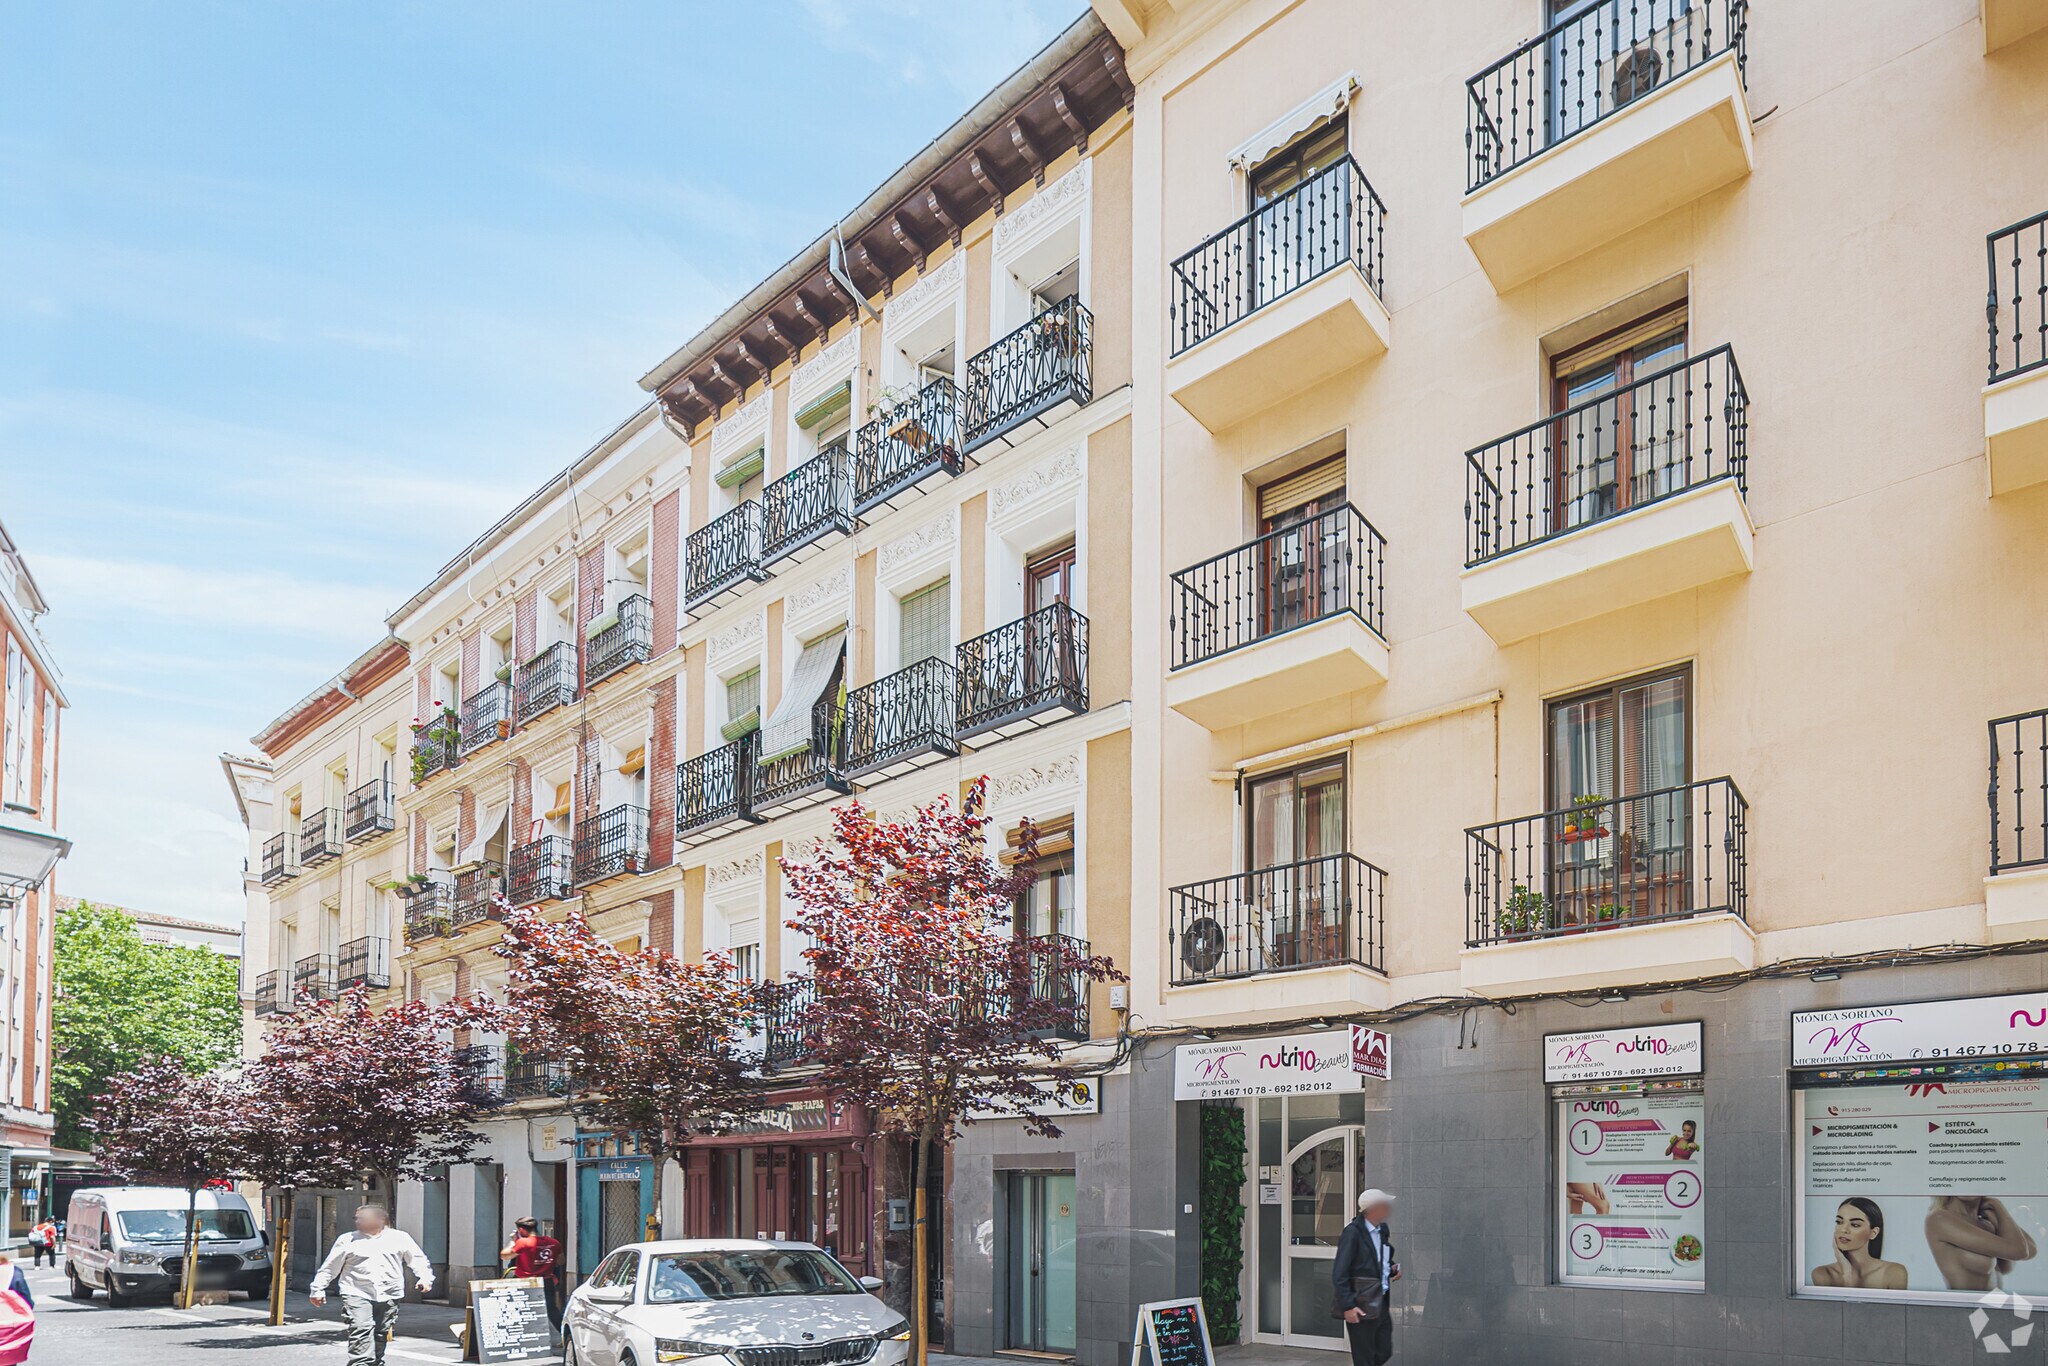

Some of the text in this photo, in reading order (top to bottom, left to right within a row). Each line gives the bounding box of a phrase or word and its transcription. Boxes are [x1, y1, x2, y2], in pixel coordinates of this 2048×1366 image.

[1795, 1008, 1893, 1024] MÓNICA SORIANO
[1575, 1033, 1605, 1041] SORIANO
[1214, 1045, 1242, 1054] SORIANO
[1353, 1052, 1369, 1061] MAR
[1932, 1048, 1949, 1057] 91
[1956, 1046, 1986, 1056] 467
[1992, 1044, 2012, 1054] 10
[2017, 1042, 2038, 1052] 78
[1314, 1053, 1349, 1073] Beauty
[1794, 1052, 1893, 1066] MICROPIGMENTACIÓN
[1353, 1062, 1387, 1077] FORMACIÓN
[1224, 1088, 1240, 1096] 467
[1255, 1086, 1266, 1094] 78
[1274, 1085, 1292, 1093] 692
[1313, 1082, 1332, 1090] 012
[1948, 1084, 2040, 1095] MICROPIGMENTACIÓN
[1581, 1130, 1588, 1145] 1
[634, 1166, 640, 1179] 5
[1677, 1182, 1688, 1197] 2
[1582, 1234, 1592, 1250] 3
